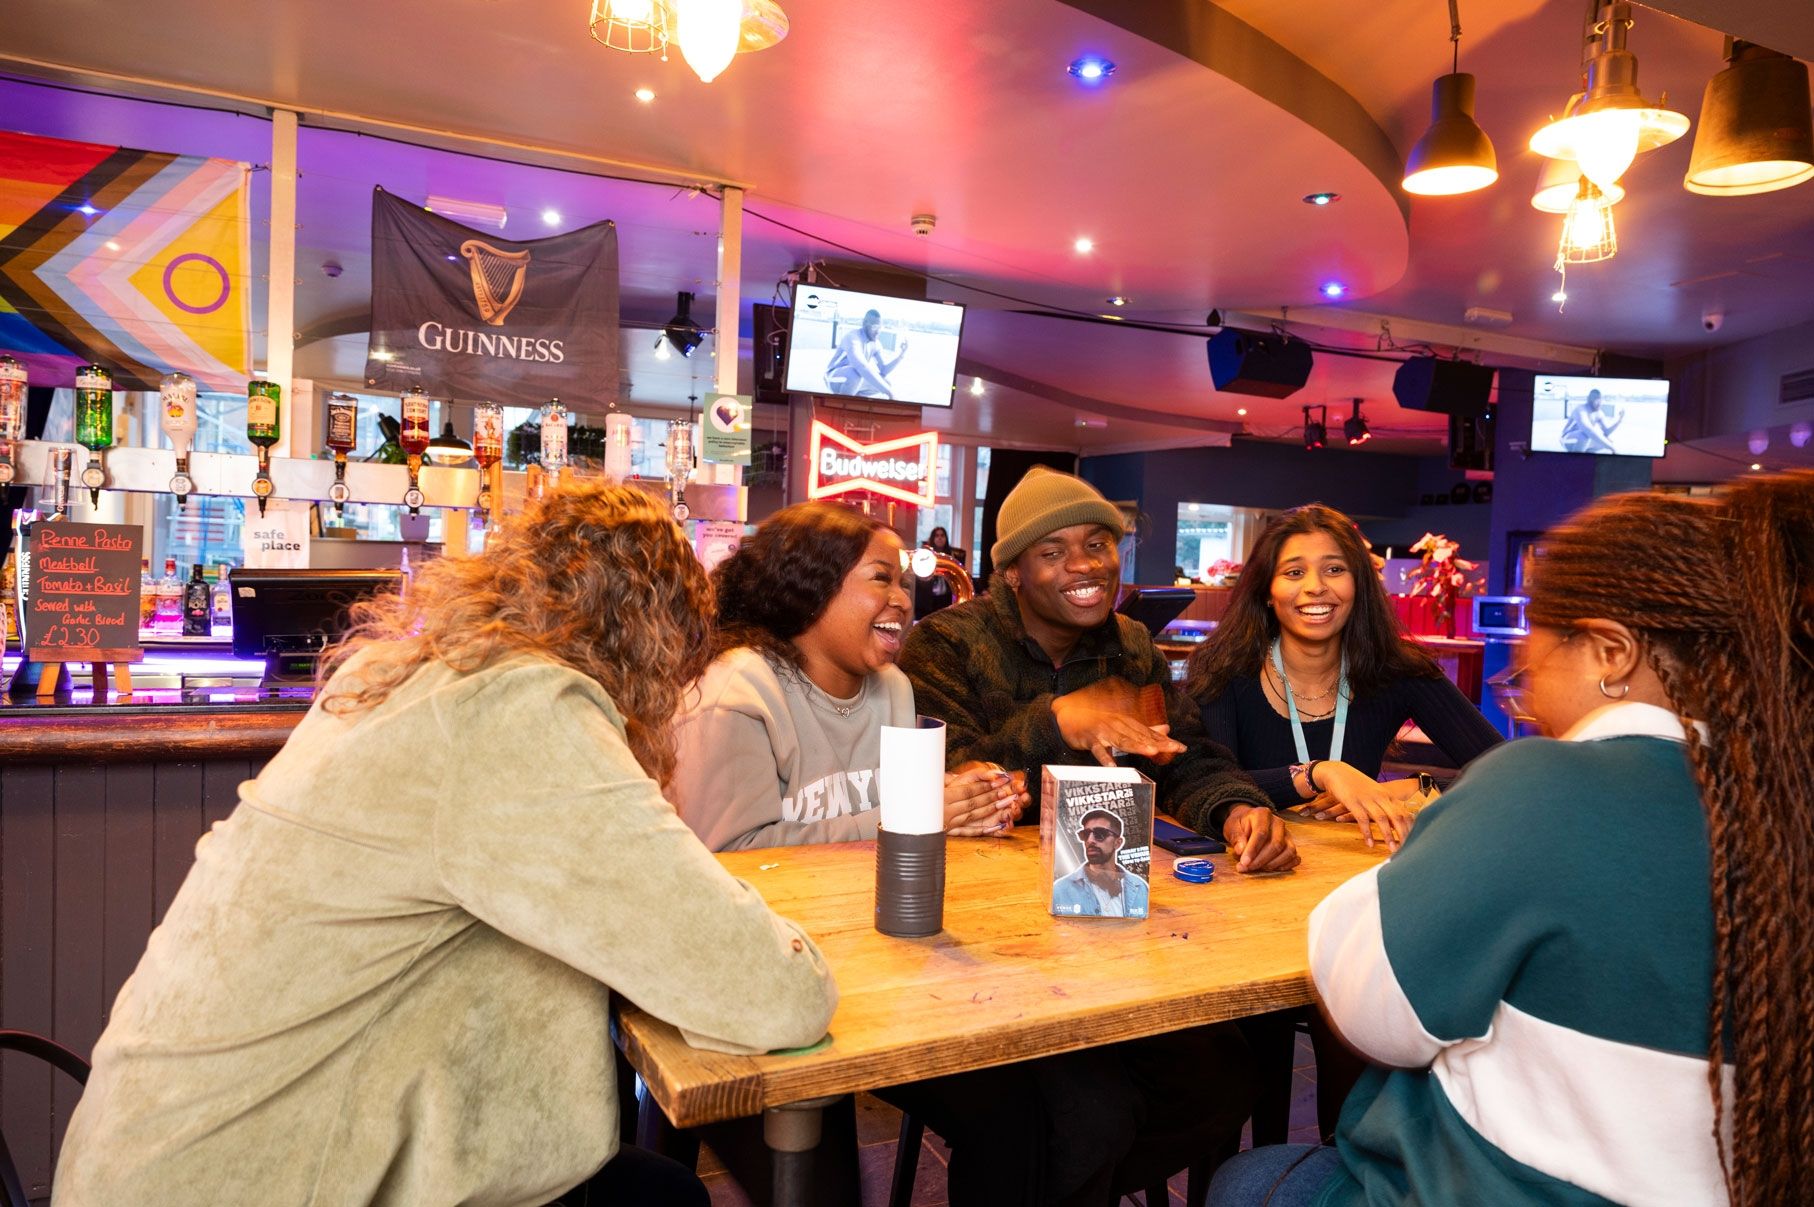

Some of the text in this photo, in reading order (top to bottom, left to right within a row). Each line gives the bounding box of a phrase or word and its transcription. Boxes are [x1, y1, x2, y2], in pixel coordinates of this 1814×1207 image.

[417, 321, 565, 363] GUINNESS
[820, 447, 929, 481] Budweiser
[40, 528, 132, 549] Penne Pasta
[253, 529, 285, 540] safe
[261, 540, 301, 552] place
[40, 556, 97, 571] Meatball
[35, 598, 96, 612] Served with
[62, 612, 91, 625] Garlic
[41, 625, 101, 647] £2.30
